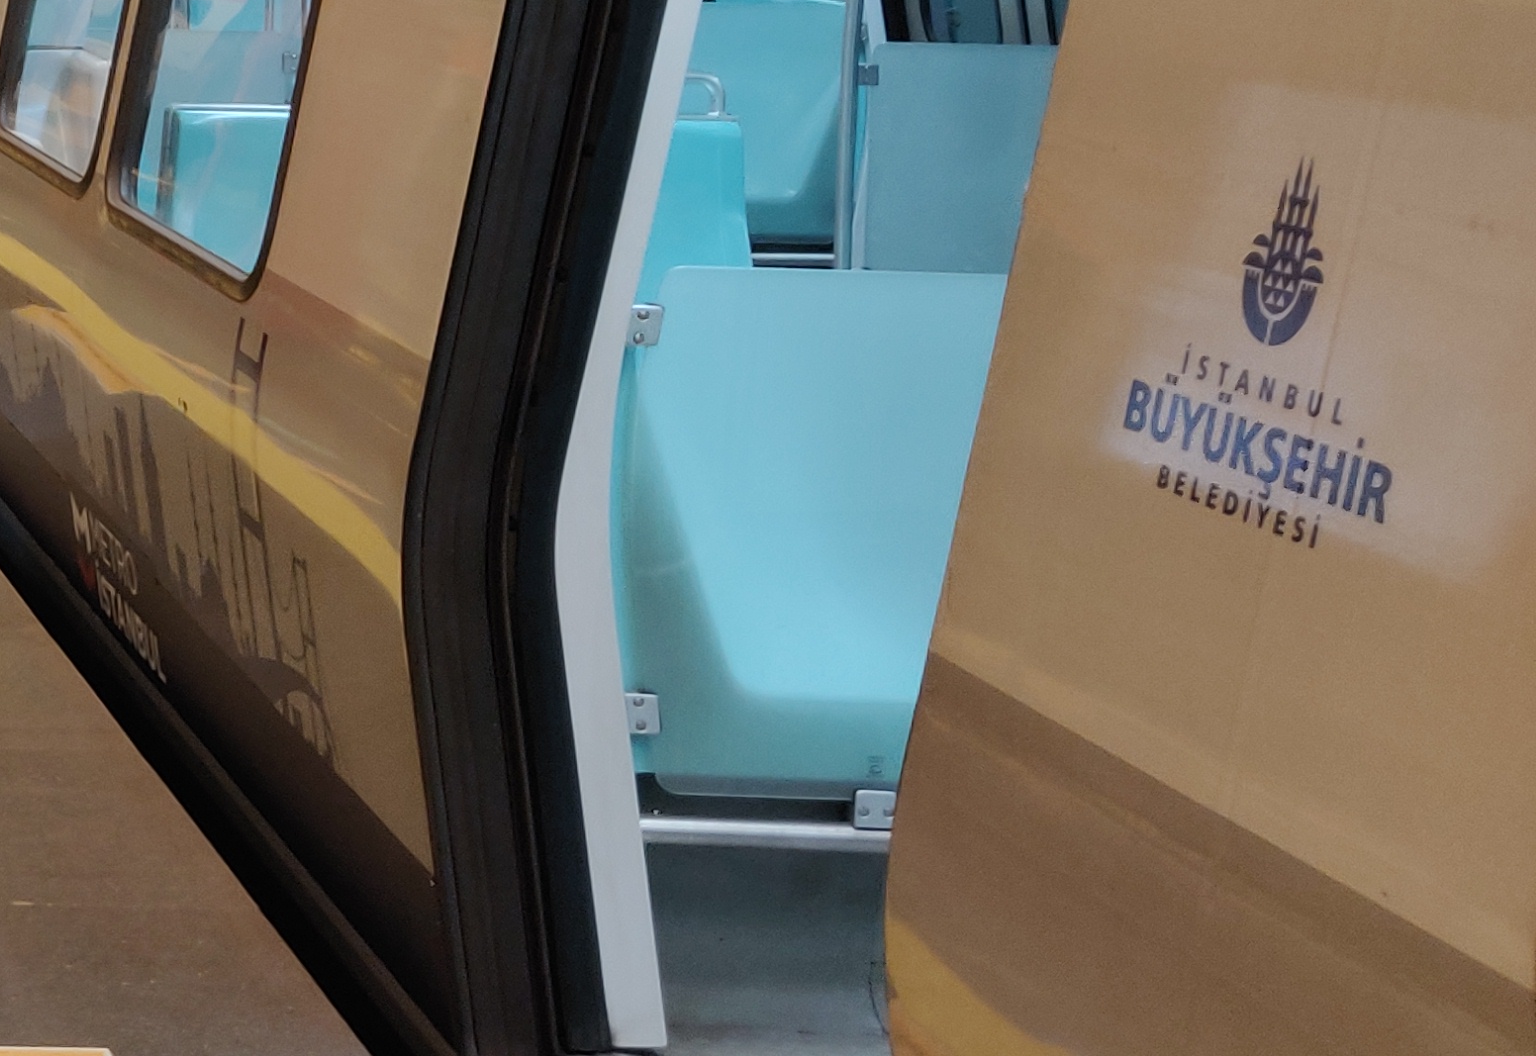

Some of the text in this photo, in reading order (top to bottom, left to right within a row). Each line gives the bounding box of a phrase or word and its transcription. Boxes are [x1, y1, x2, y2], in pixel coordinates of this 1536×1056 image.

[1181, 343, 1343, 426] İSTANBUL
[1123, 372, 1393, 524] BÜYÜKŞEHİR
[1156, 464, 1322, 549] BELEDİYESİ
